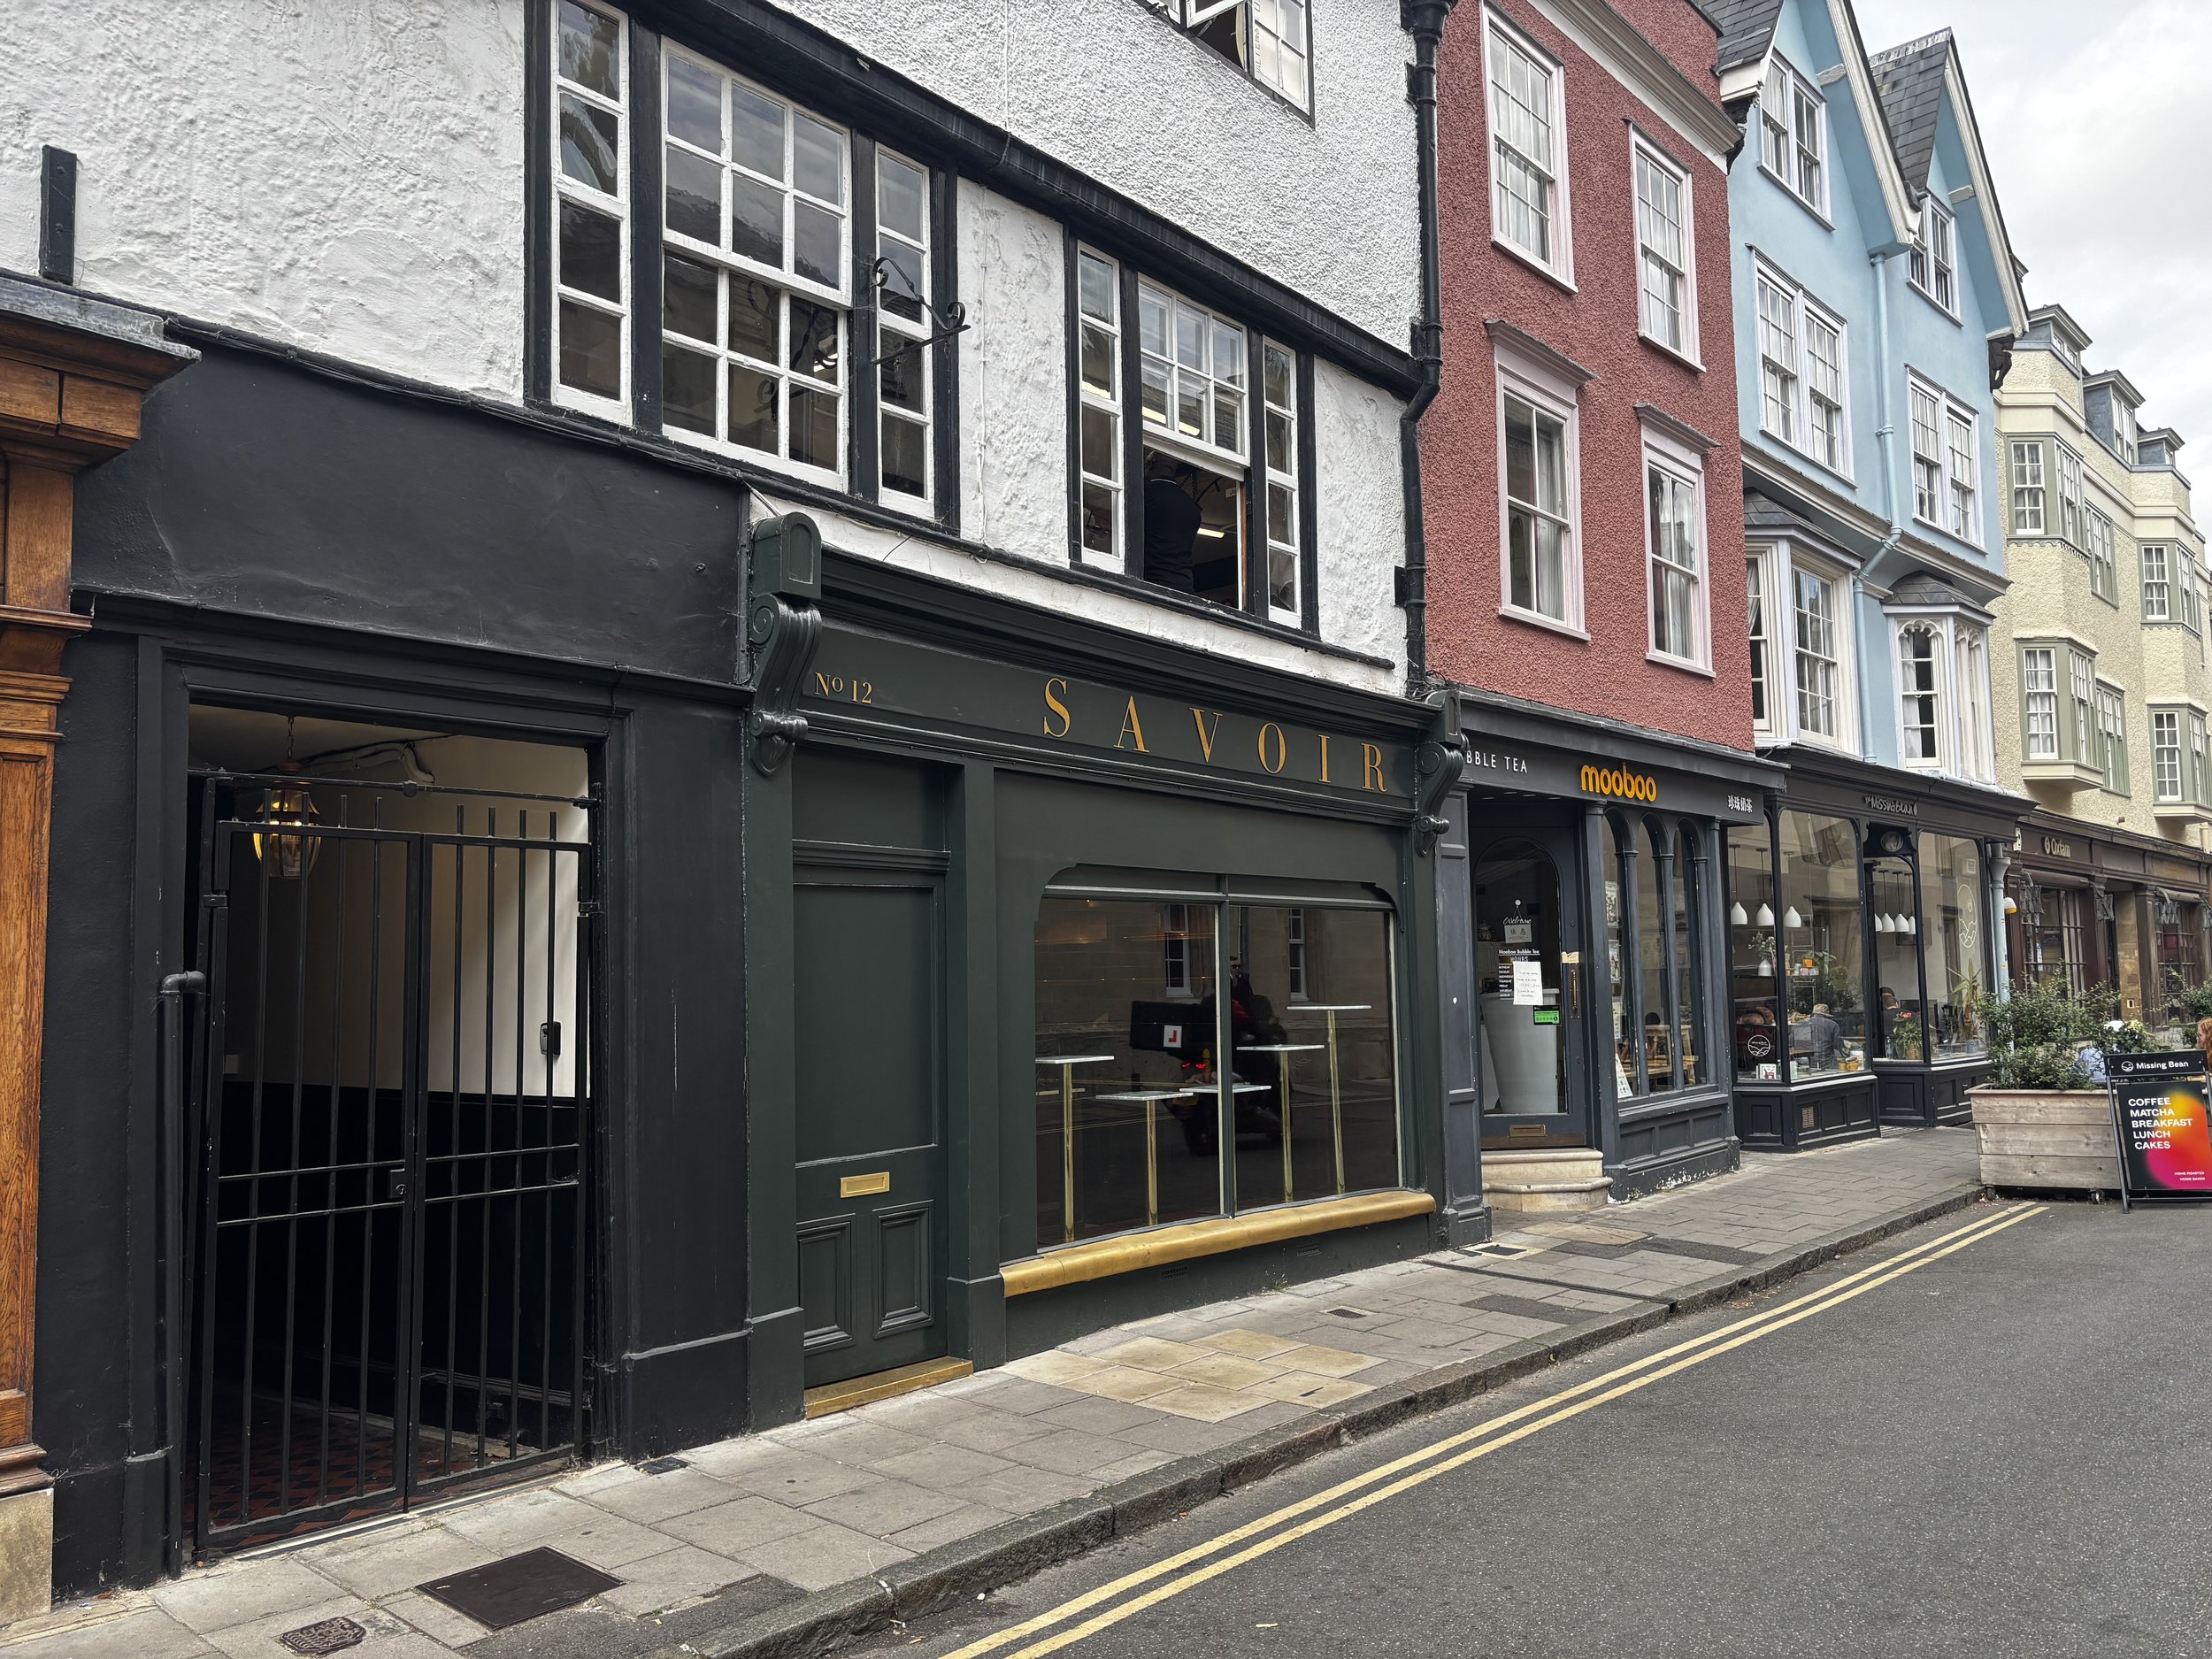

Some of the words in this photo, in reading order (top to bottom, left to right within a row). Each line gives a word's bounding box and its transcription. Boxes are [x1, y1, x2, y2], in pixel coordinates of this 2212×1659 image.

[814, 672, 843, 696] No
[851, 680, 872, 704] 12
[1043, 678, 1386, 792] SAVOIR
[1466, 750, 1497, 768] BBLE
[1504, 757, 1527, 773] TEA
[1580, 762, 1657, 803] mooboo
[2051, 838, 2071, 857] Oxfam
[2128, 1097, 2171, 1106] COFFEE
[2130, 1109, 2175, 1118] MATCHA
[2131, 1118, 2193, 1128] BREAKFAST
[2133, 1130, 2170, 1139] LUNCH
[2134, 1141, 2170, 1150] CAKES
